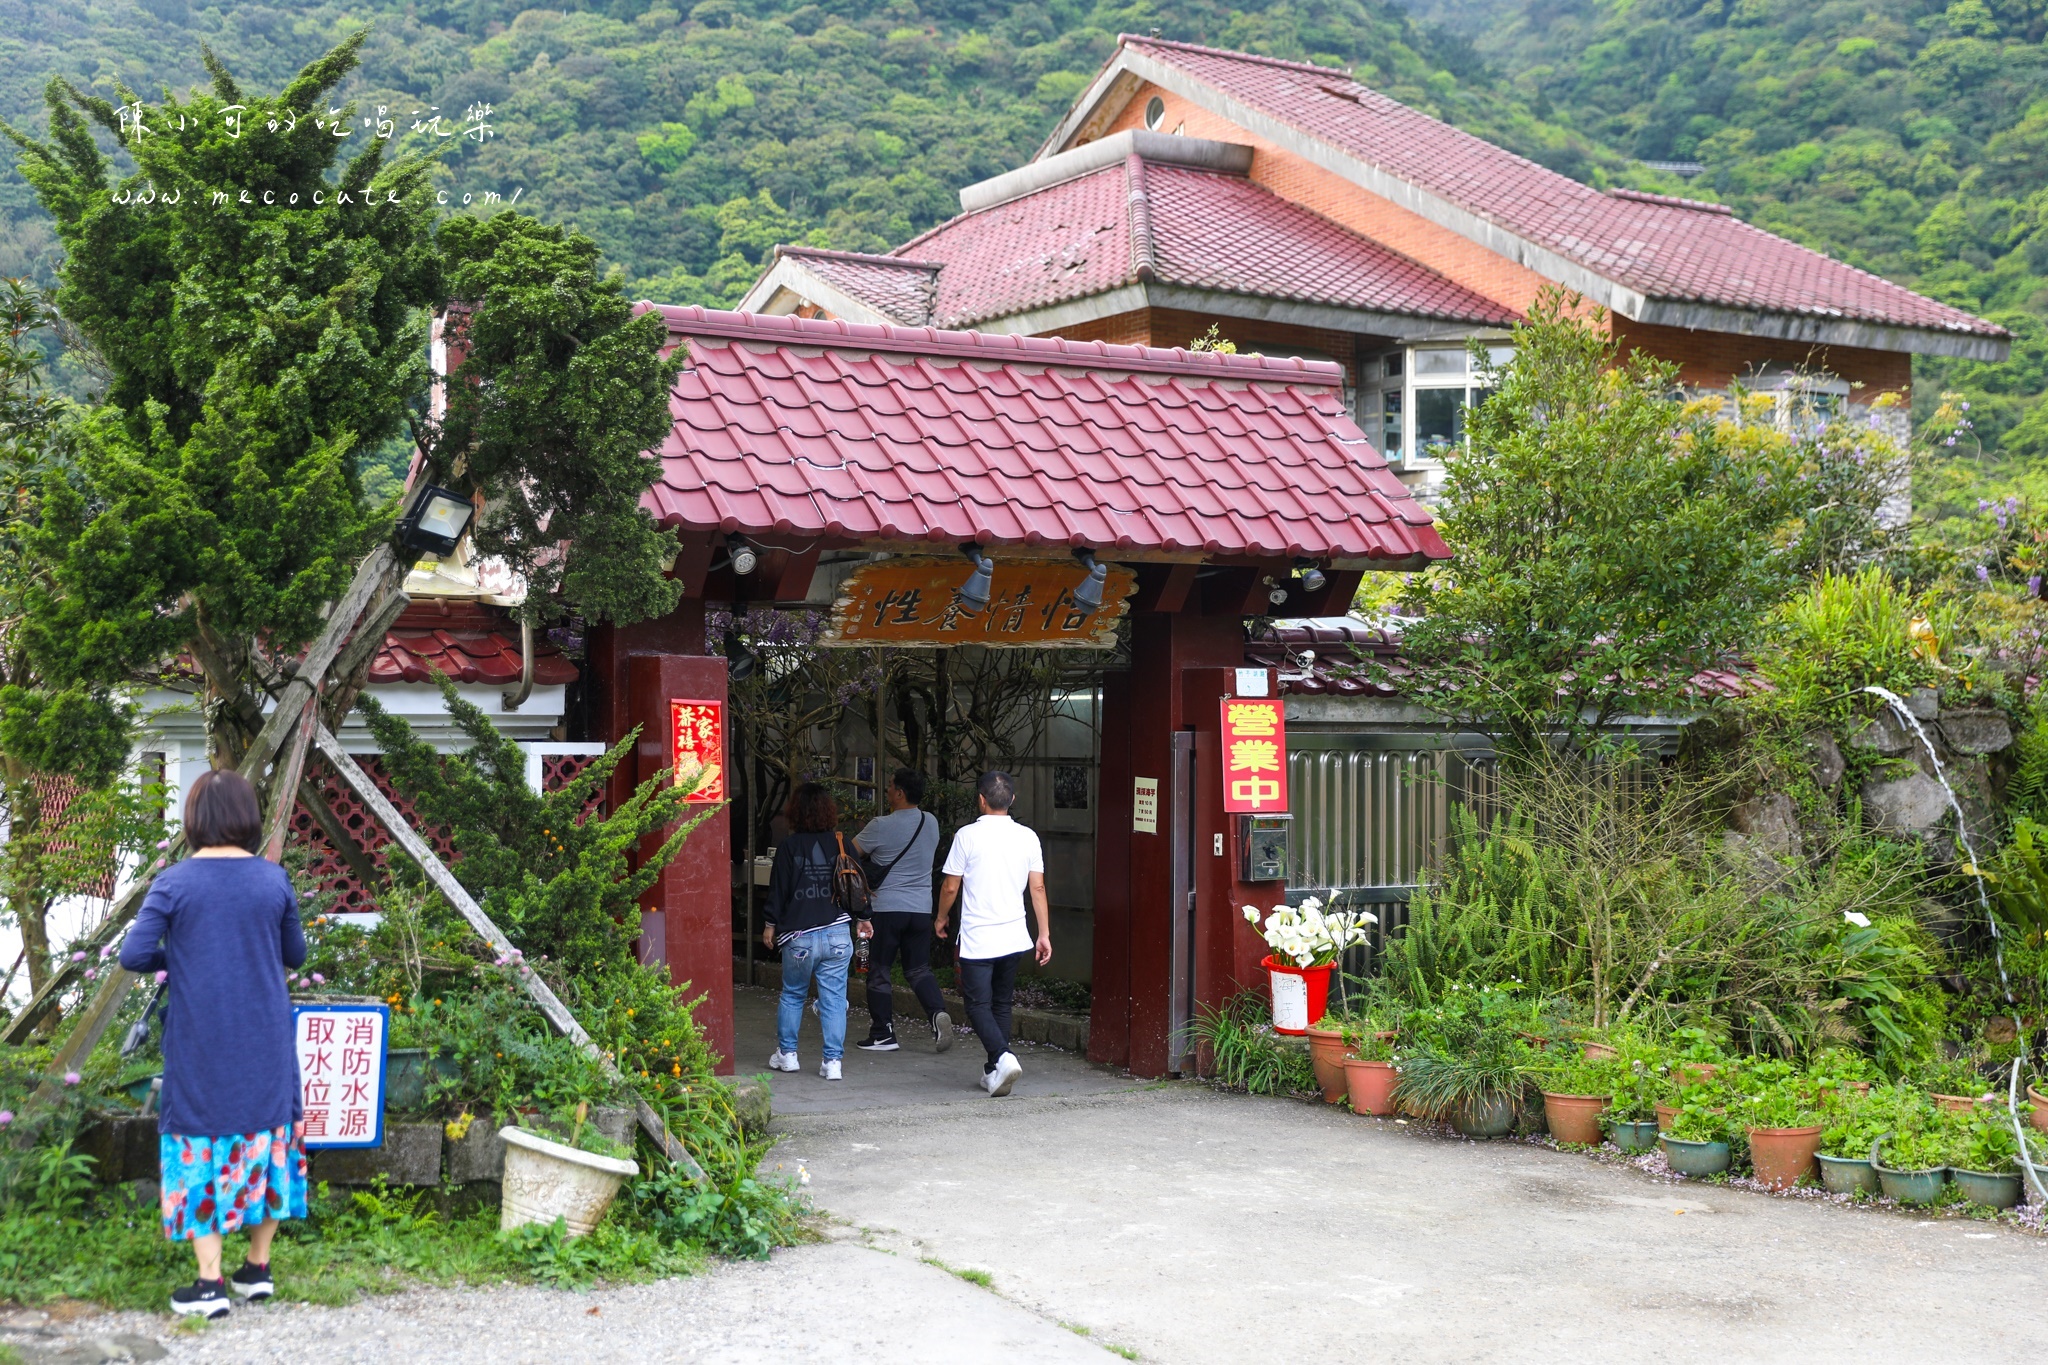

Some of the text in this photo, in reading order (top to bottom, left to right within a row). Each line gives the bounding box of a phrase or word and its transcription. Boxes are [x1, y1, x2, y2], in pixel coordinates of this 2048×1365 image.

[1228, 704, 1279, 809] 營業中
[794, 883, 832, 900] adid
[303, 1017, 335, 1137] 取水位置
[338, 1017, 374, 1137] 消防水源
